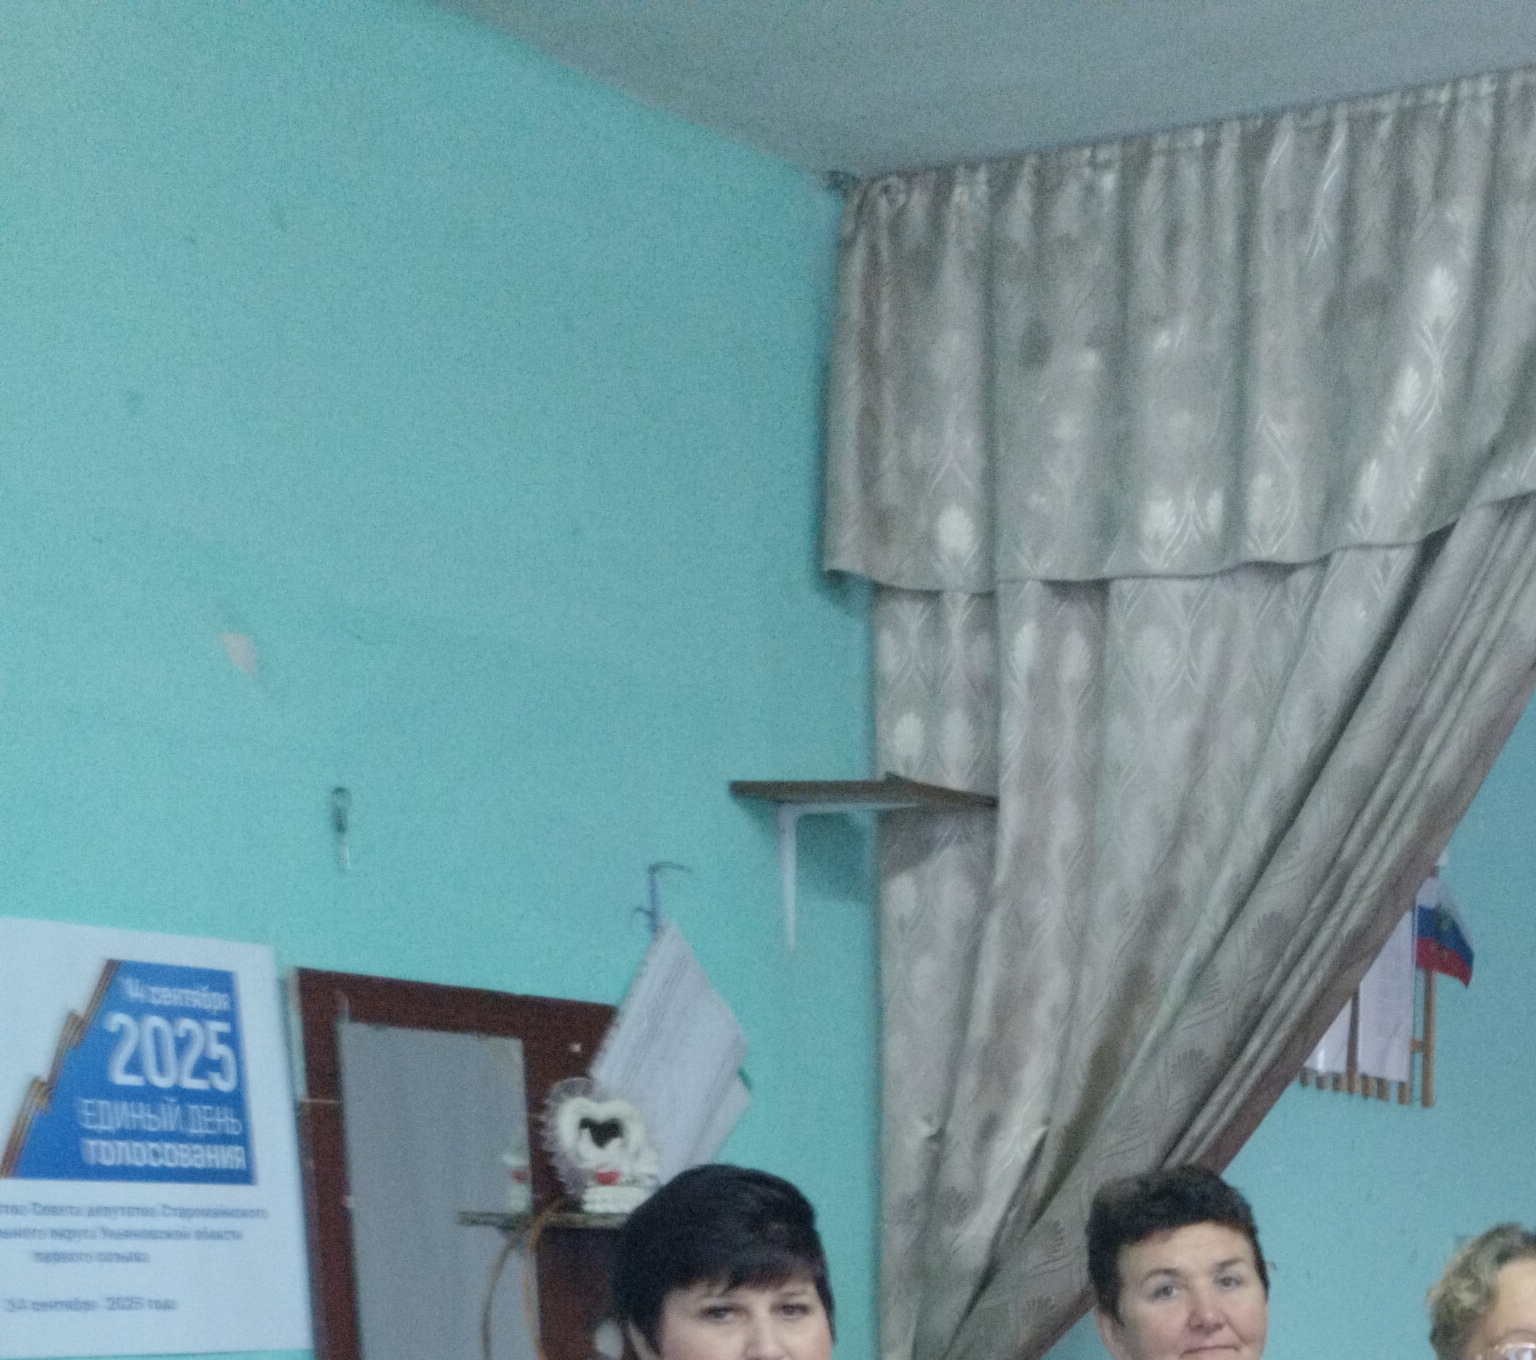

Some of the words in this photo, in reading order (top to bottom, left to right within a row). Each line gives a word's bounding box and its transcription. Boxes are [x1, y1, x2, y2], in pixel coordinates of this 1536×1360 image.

[146, 984, 230, 1013] сентября
[103, 1011, 238, 1092] 2025
[77, 1096, 182, 1134] ЕДИНЫЙ
[186, 1103, 243, 1136] ДЕНЬ
[104, 1297, 145, 1311] 2025
